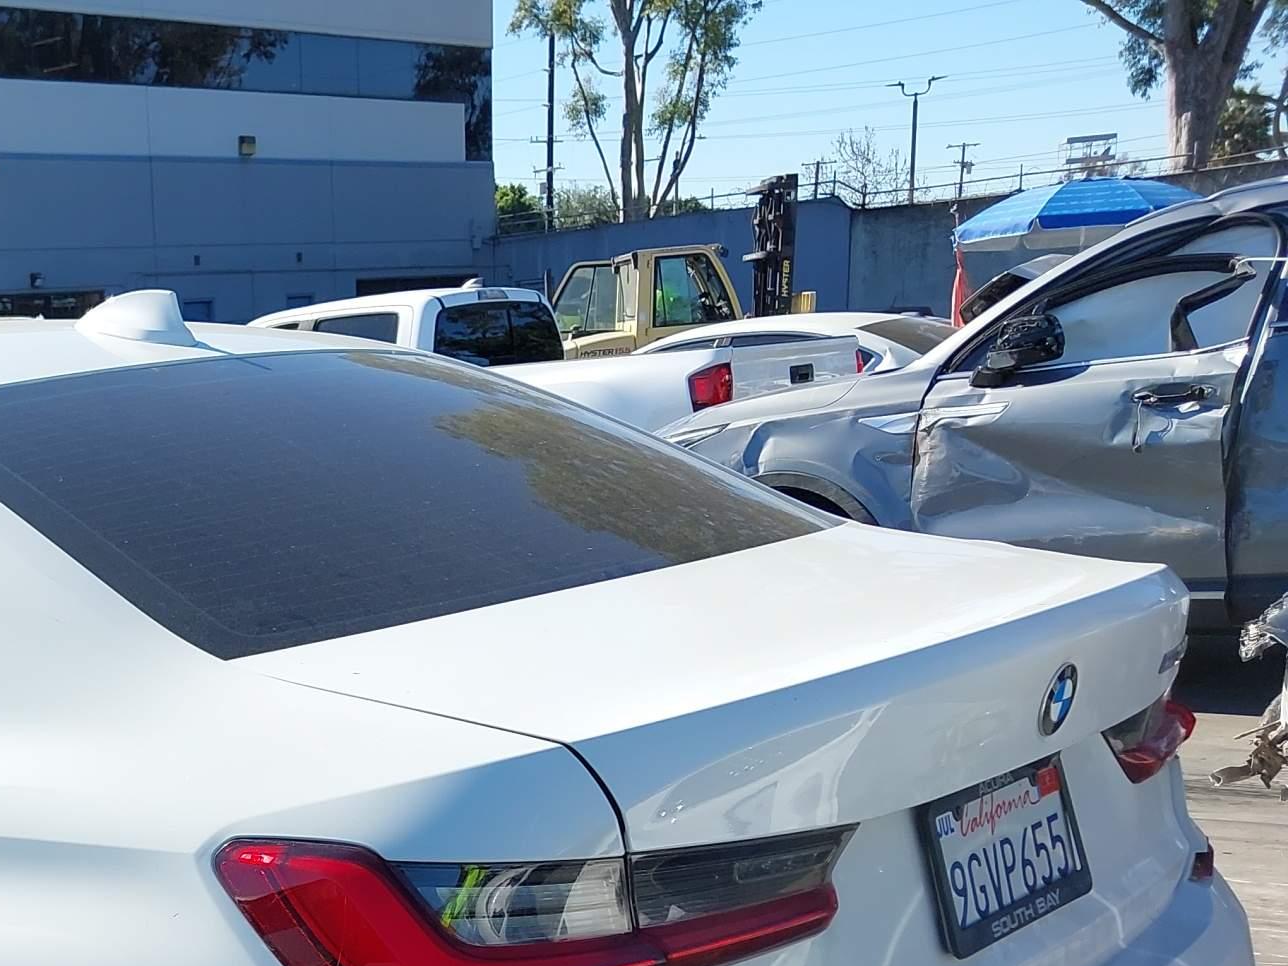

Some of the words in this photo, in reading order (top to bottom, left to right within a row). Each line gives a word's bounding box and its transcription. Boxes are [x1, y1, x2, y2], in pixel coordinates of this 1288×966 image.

[781, 259, 791, 298] HYSTER
[978, 772, 1015, 795] ACURA
[937, 814, 955, 839] JUL
[957, 788, 1042, 837] California
[949, 812, 1071, 929] 9GVP655
[991, 902, 1035, 938] SOUTH
[1037, 888, 1061, 915] BAY
